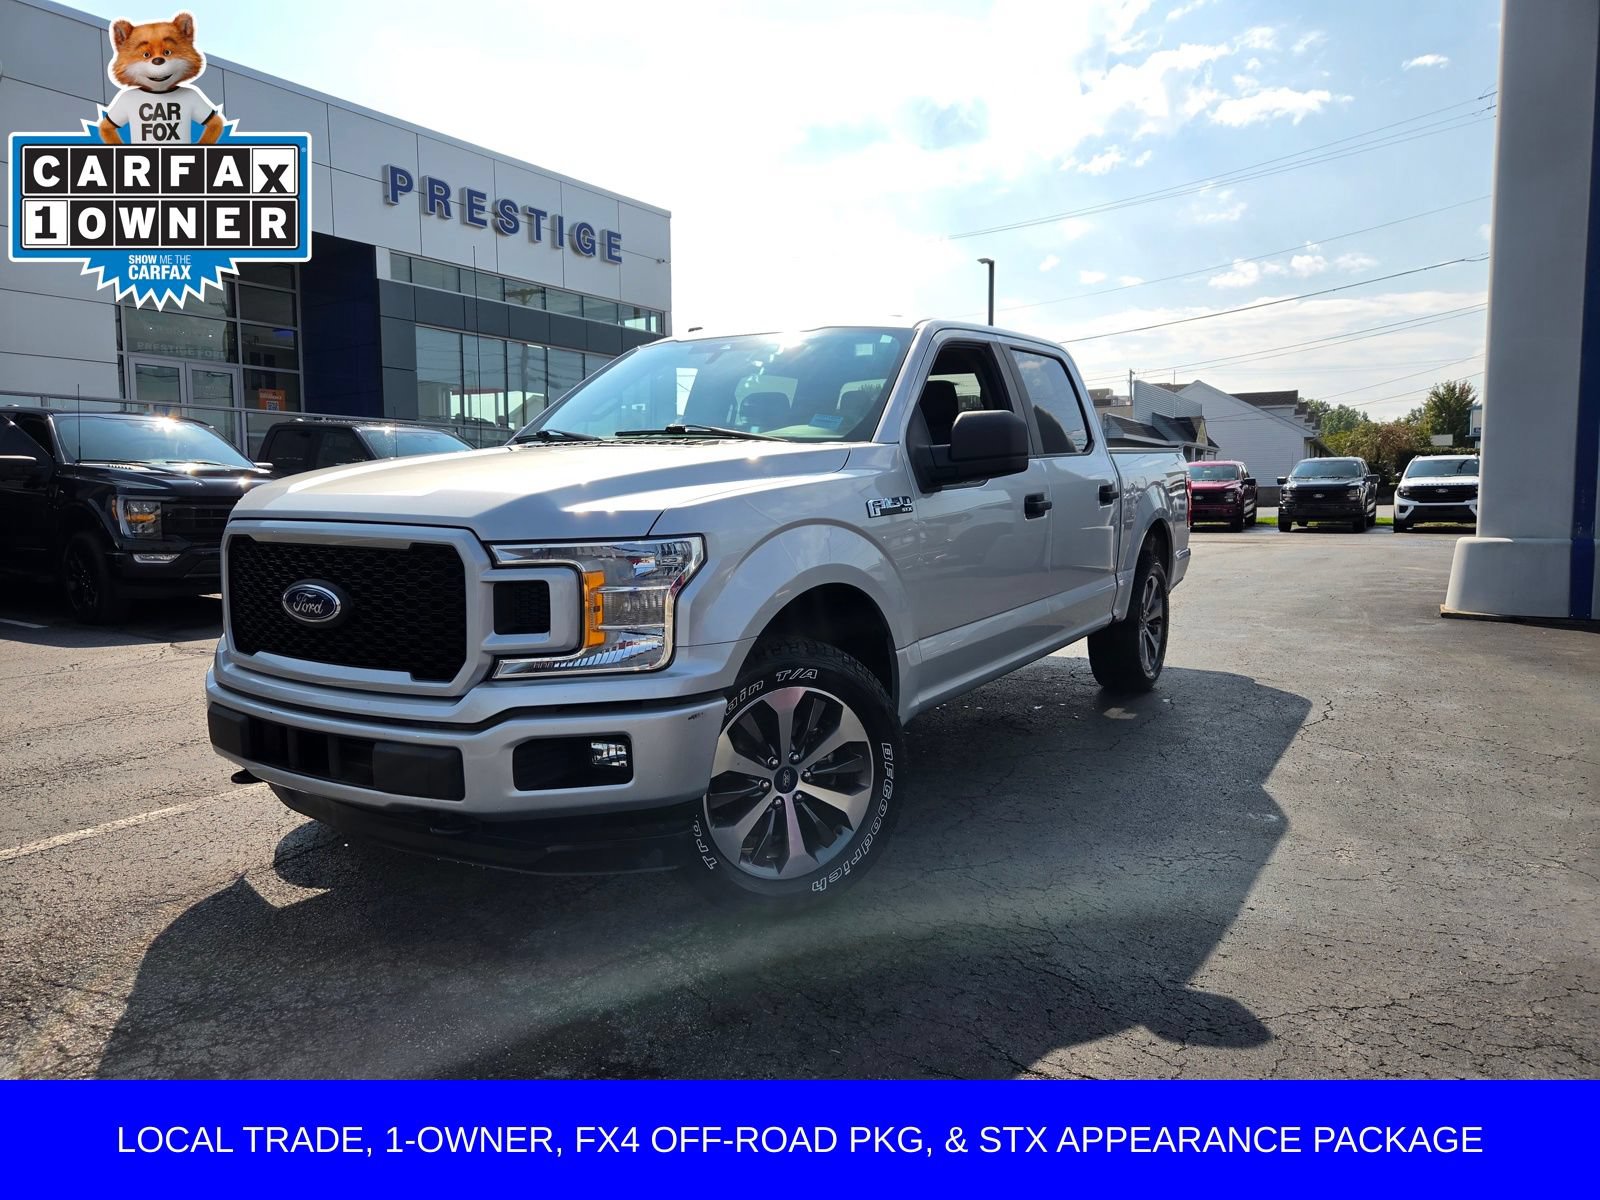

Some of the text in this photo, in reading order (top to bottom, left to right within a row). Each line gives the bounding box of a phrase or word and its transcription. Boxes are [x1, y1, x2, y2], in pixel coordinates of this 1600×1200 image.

[383, 163, 623, 265] PRESTIGE
[292, 592, 325, 614] Ford
[725, 668, 818, 716] ain T/A
[811, 742, 895, 892] BFGoodrich
